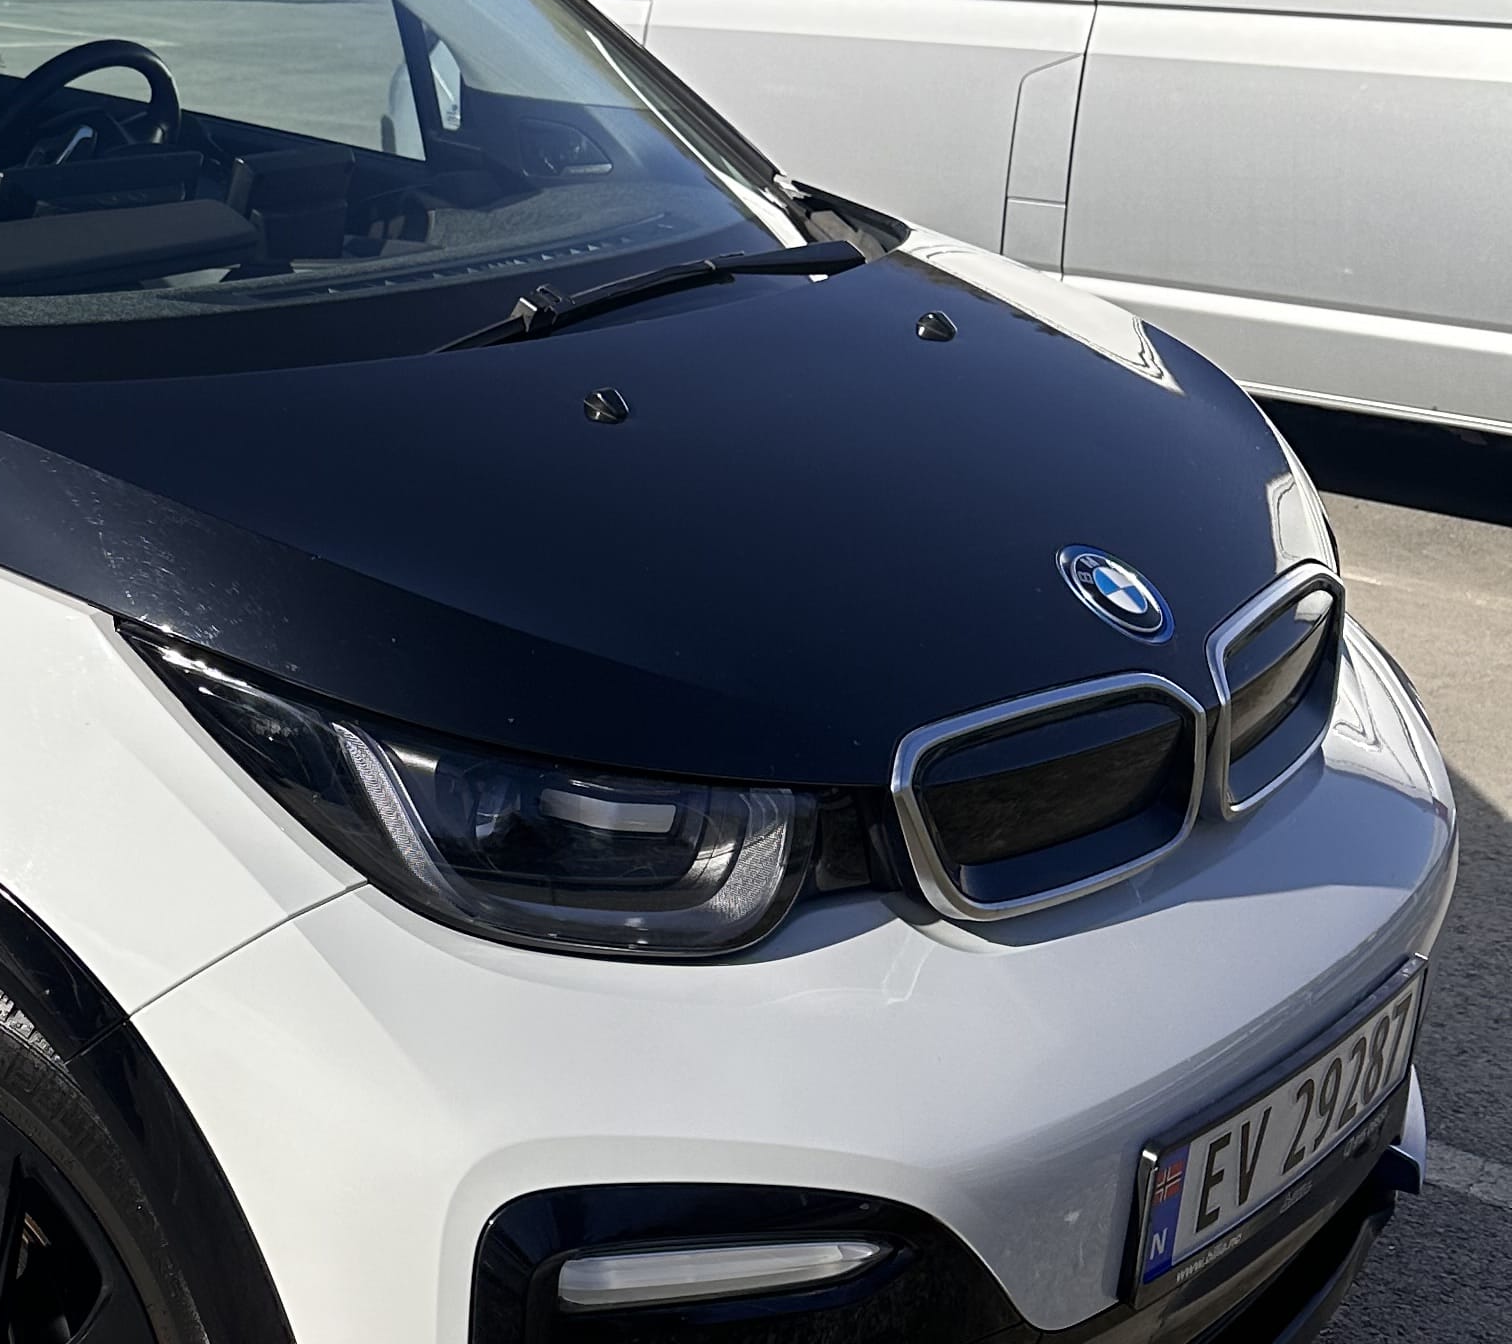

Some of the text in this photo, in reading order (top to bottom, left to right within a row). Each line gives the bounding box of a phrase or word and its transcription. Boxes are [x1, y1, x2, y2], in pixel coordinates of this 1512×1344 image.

[1195, 993, 1413, 1234] EV 29287
[1149, 1227, 1169, 1261] N
